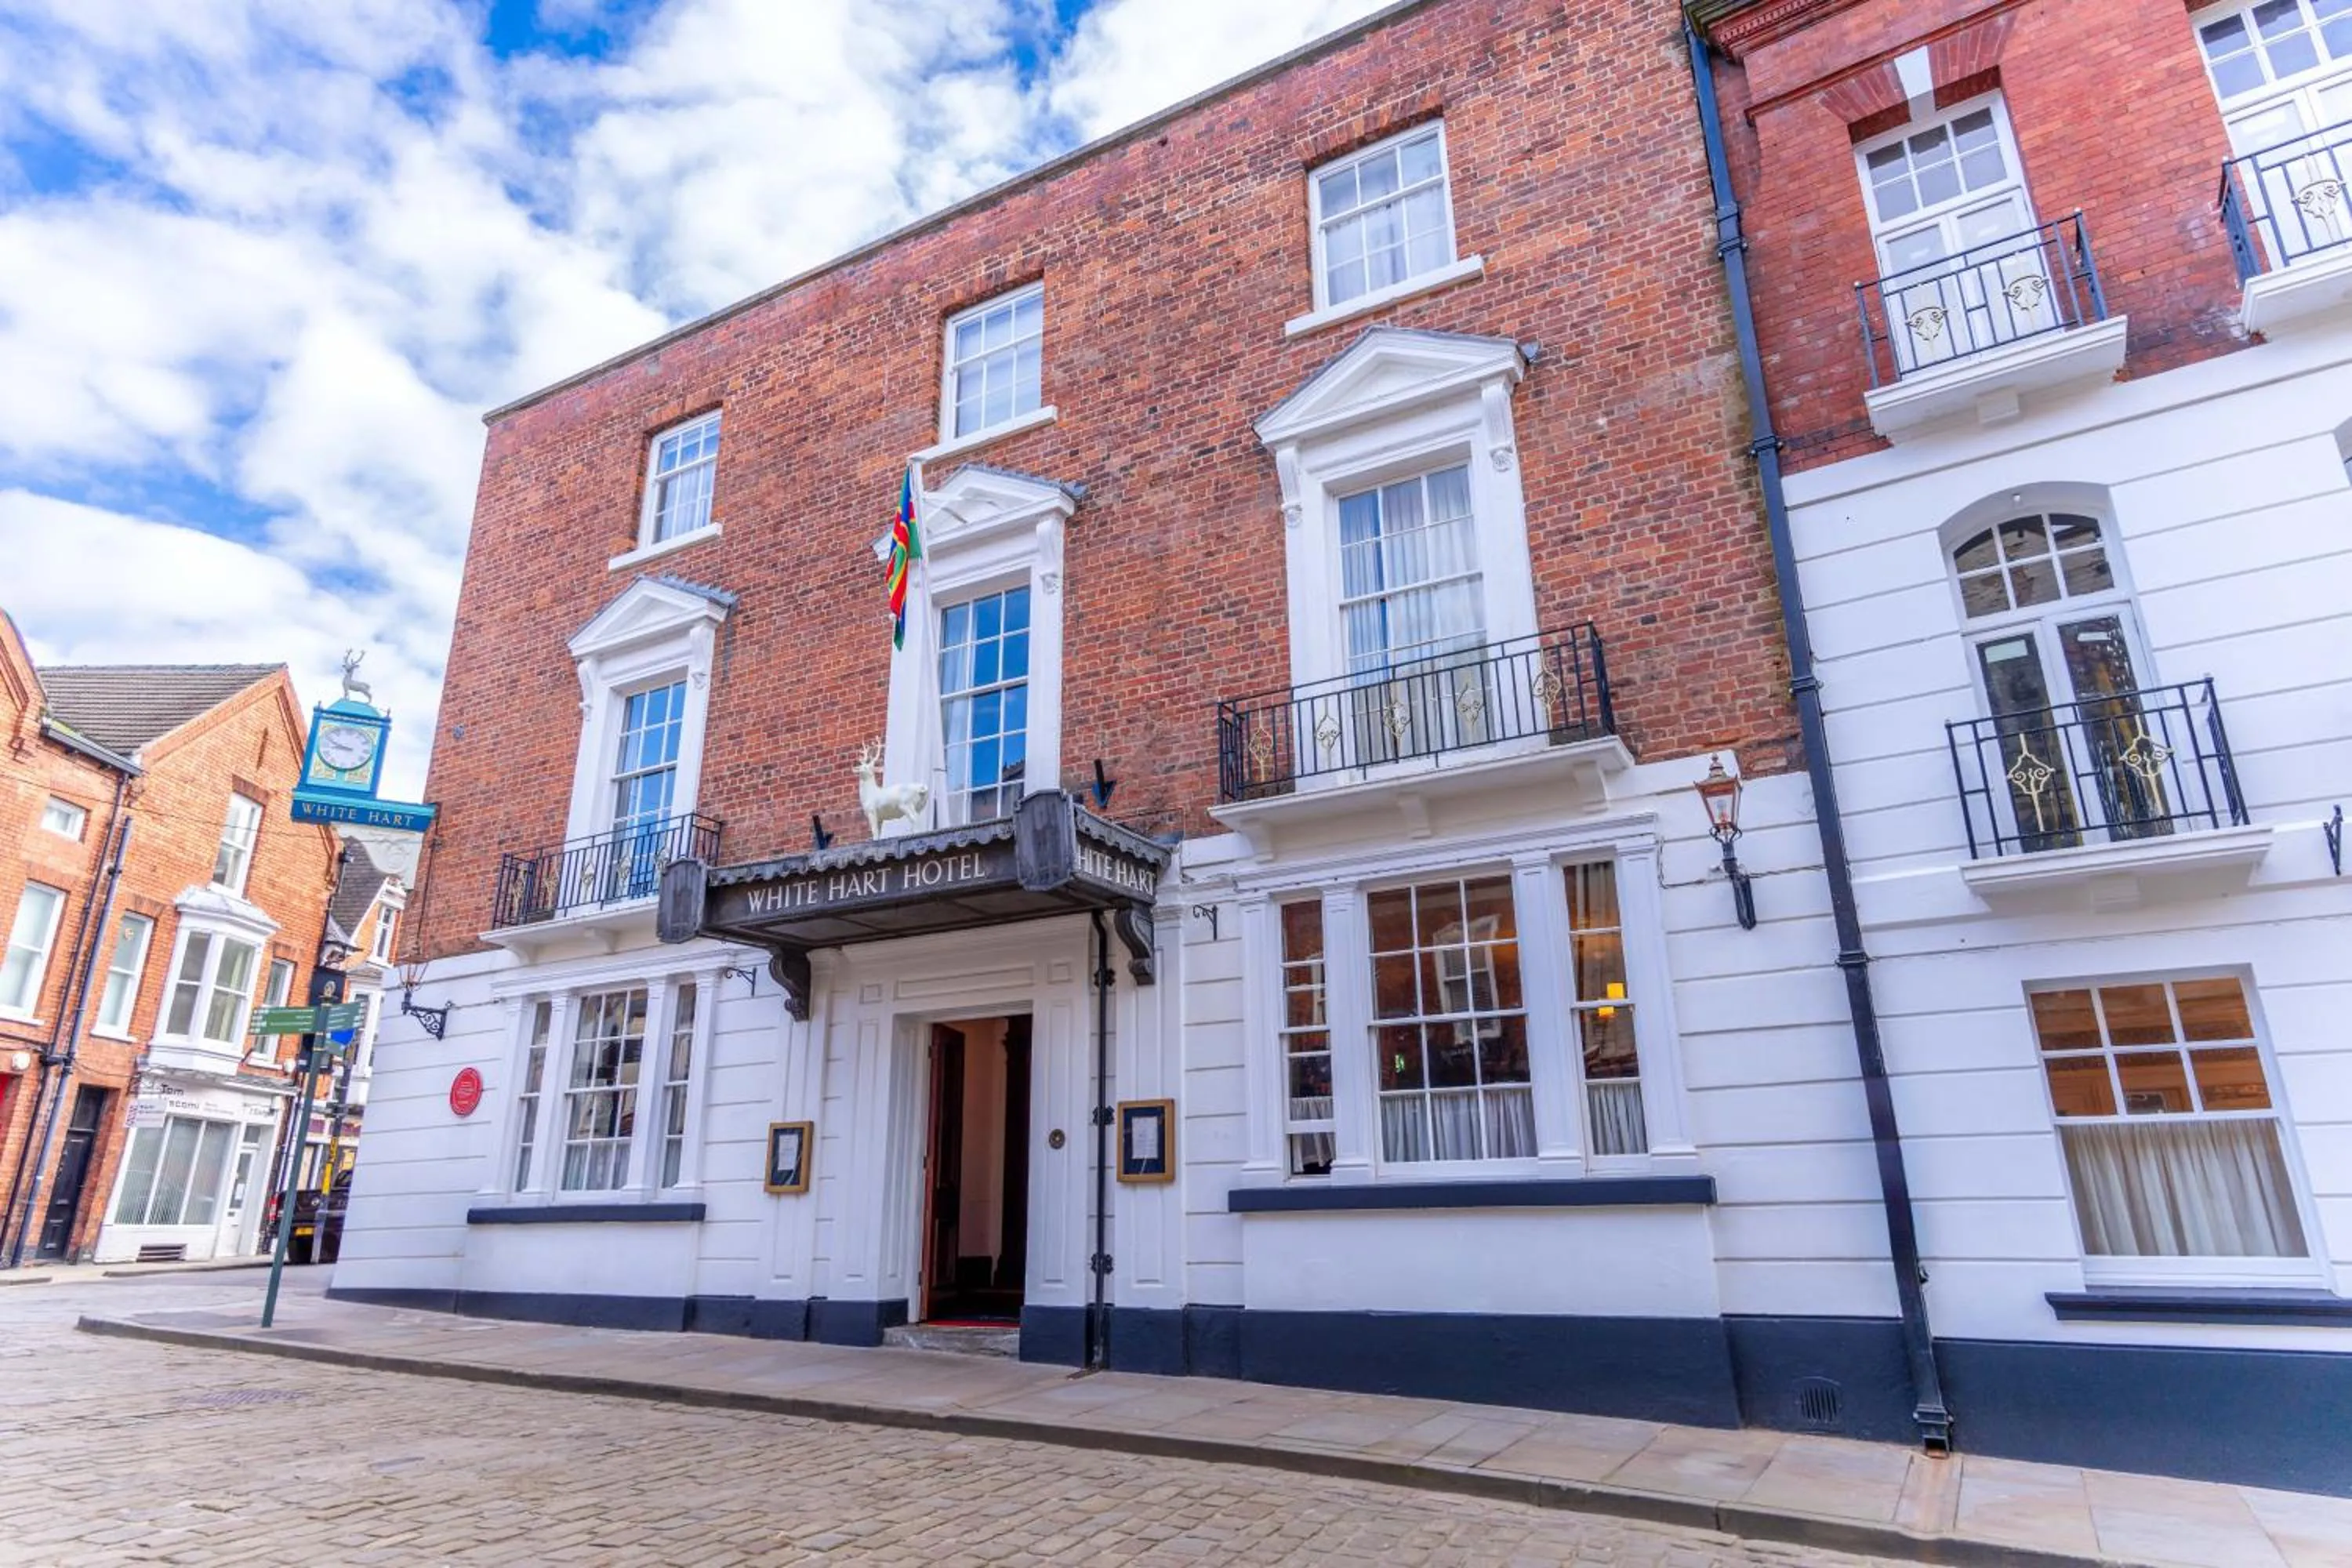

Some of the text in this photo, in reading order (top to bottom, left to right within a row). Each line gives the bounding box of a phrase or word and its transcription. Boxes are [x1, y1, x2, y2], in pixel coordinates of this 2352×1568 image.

[302, 802, 414, 826] WHITE HART
[747, 852, 985, 913] WHITE HART HOTEL
[1077, 844, 1156, 895] HITE HART
[161, 1083, 184, 1096] Tom
